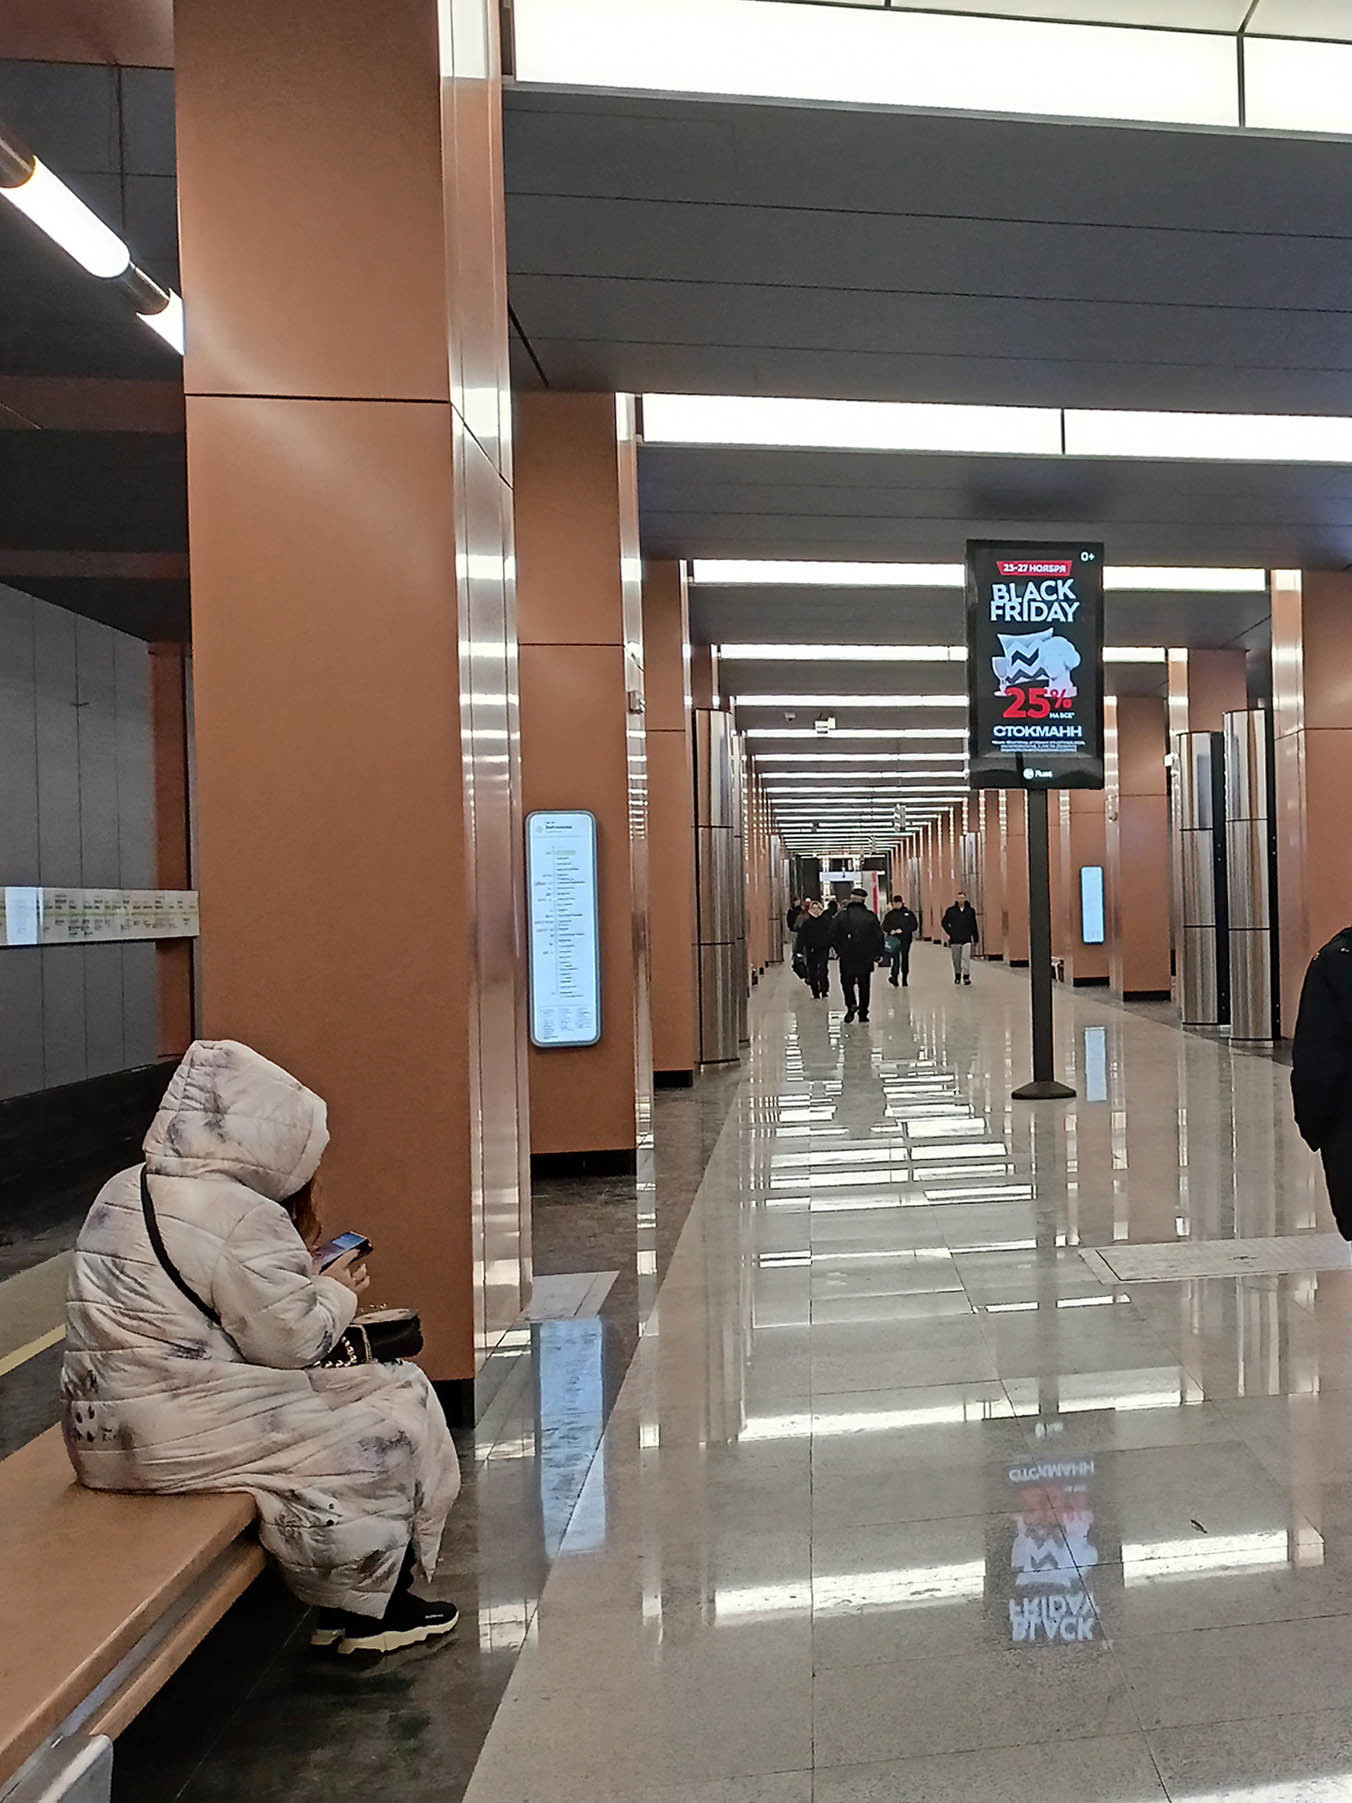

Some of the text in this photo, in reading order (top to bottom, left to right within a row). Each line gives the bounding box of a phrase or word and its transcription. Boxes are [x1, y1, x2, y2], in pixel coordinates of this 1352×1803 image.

[1080, 551, 1095, 562] 0+
[1029, 564, 1067, 573] НОЯБРЯ
[992, 578, 1077, 603] BLACK
[990, 601, 1080, 622] FRIDAY
[1003, 687, 1073, 719] 25%
[993, 725, 1083, 738] СТОКМАНН
